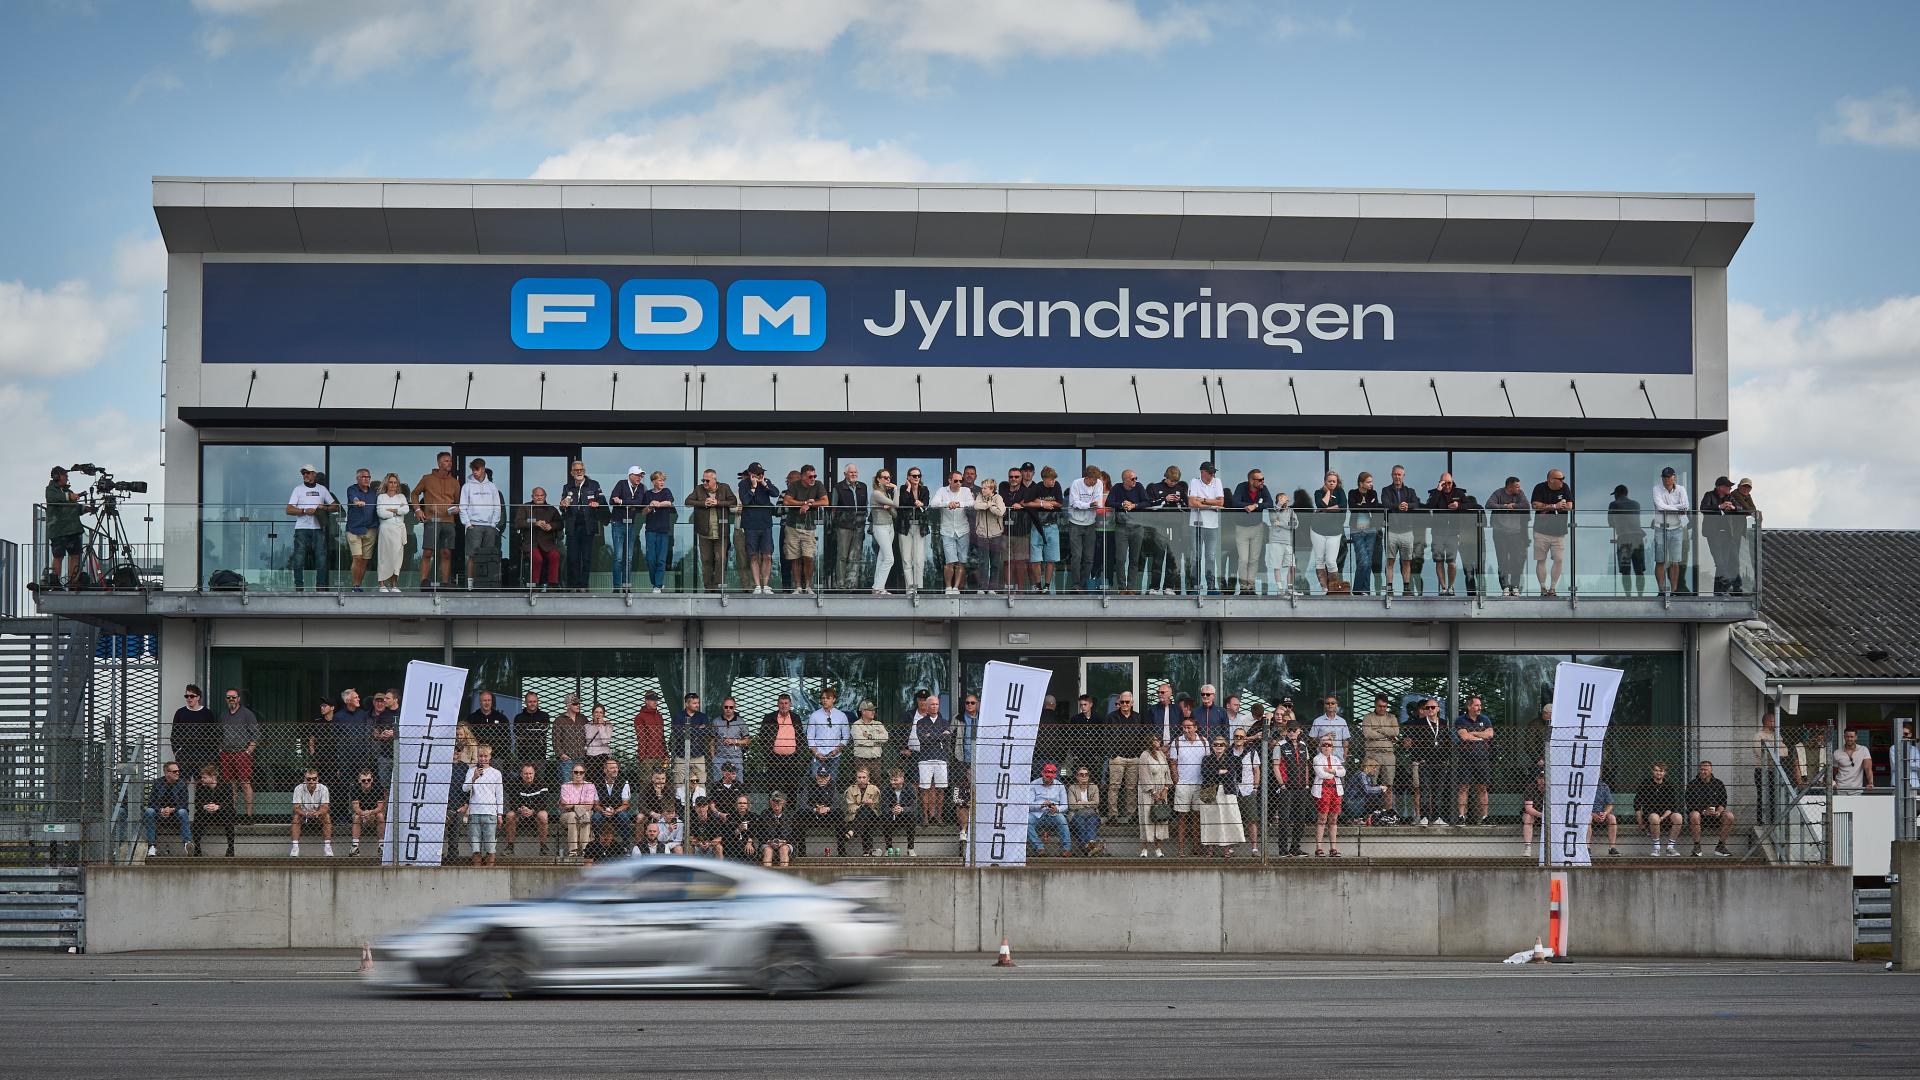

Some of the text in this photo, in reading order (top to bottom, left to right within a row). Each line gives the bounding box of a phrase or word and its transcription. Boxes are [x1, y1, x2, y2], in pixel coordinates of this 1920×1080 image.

[527, 286, 1396, 353] FDM Jyllandsringen
[405, 681, 443, 864] ORSCHE
[990, 682, 1025, 865] ORSCHE
